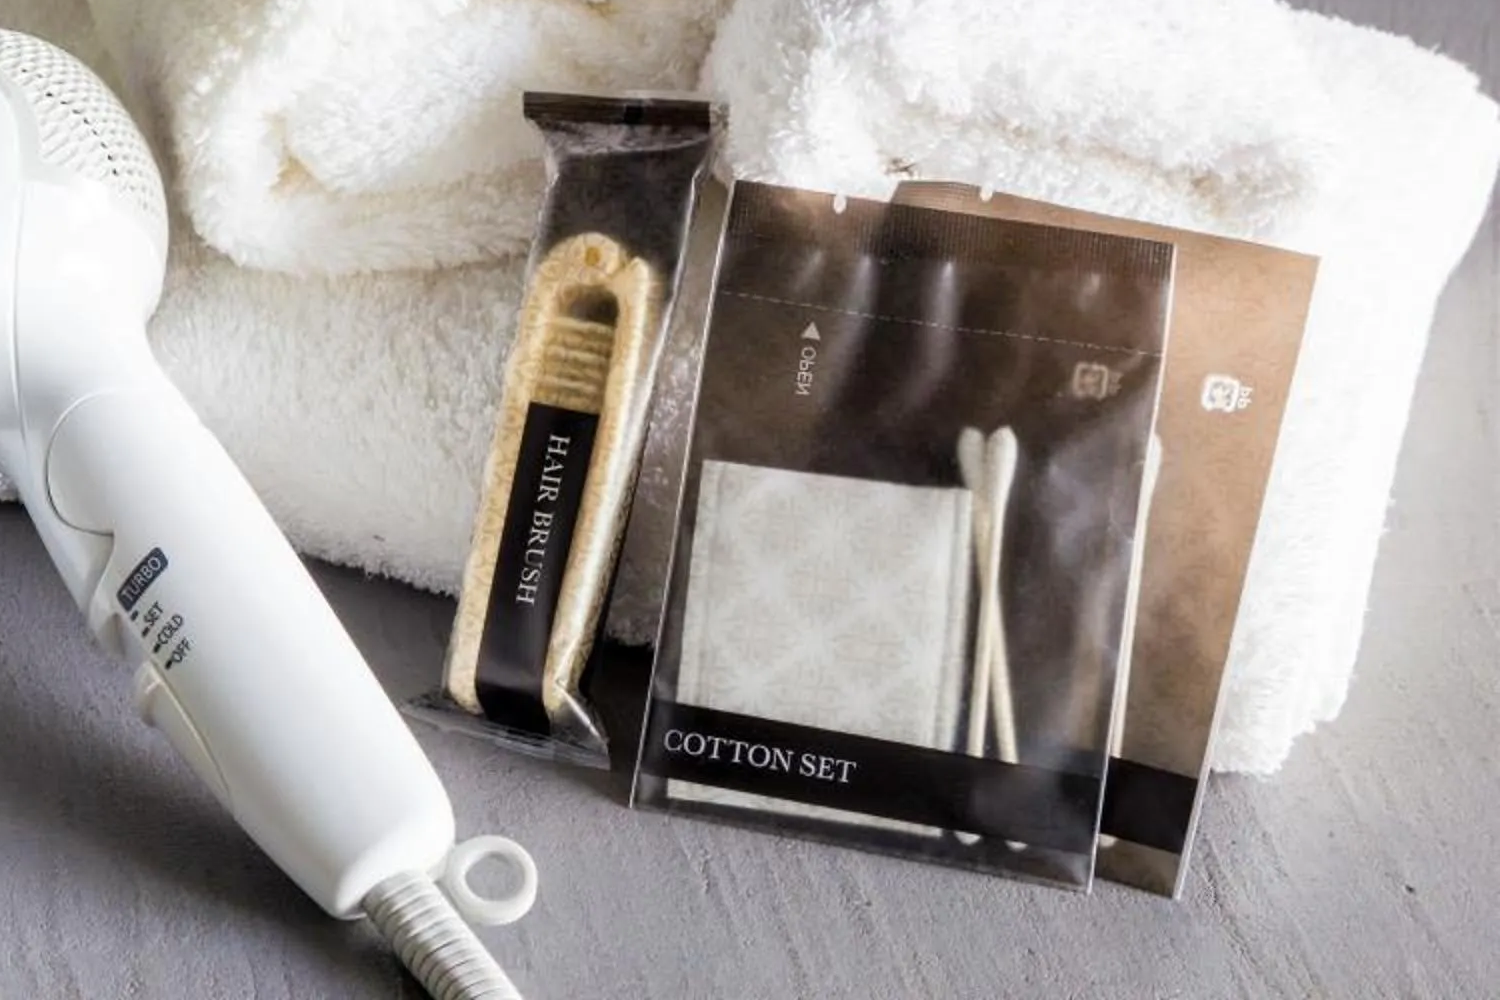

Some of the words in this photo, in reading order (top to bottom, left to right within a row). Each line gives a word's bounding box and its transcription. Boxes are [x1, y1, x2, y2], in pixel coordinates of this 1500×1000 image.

[537, 433, 572, 503] HAIR
[123, 557, 161, 601] TURBO
[515, 509, 555, 608] BRUSH
[144, 601, 164, 627] SET
[157, 614, 184, 645] COLD
[171, 637, 191, 663] OFF
[663, 728, 794, 773] COTTON
[799, 752, 857, 783] SET
